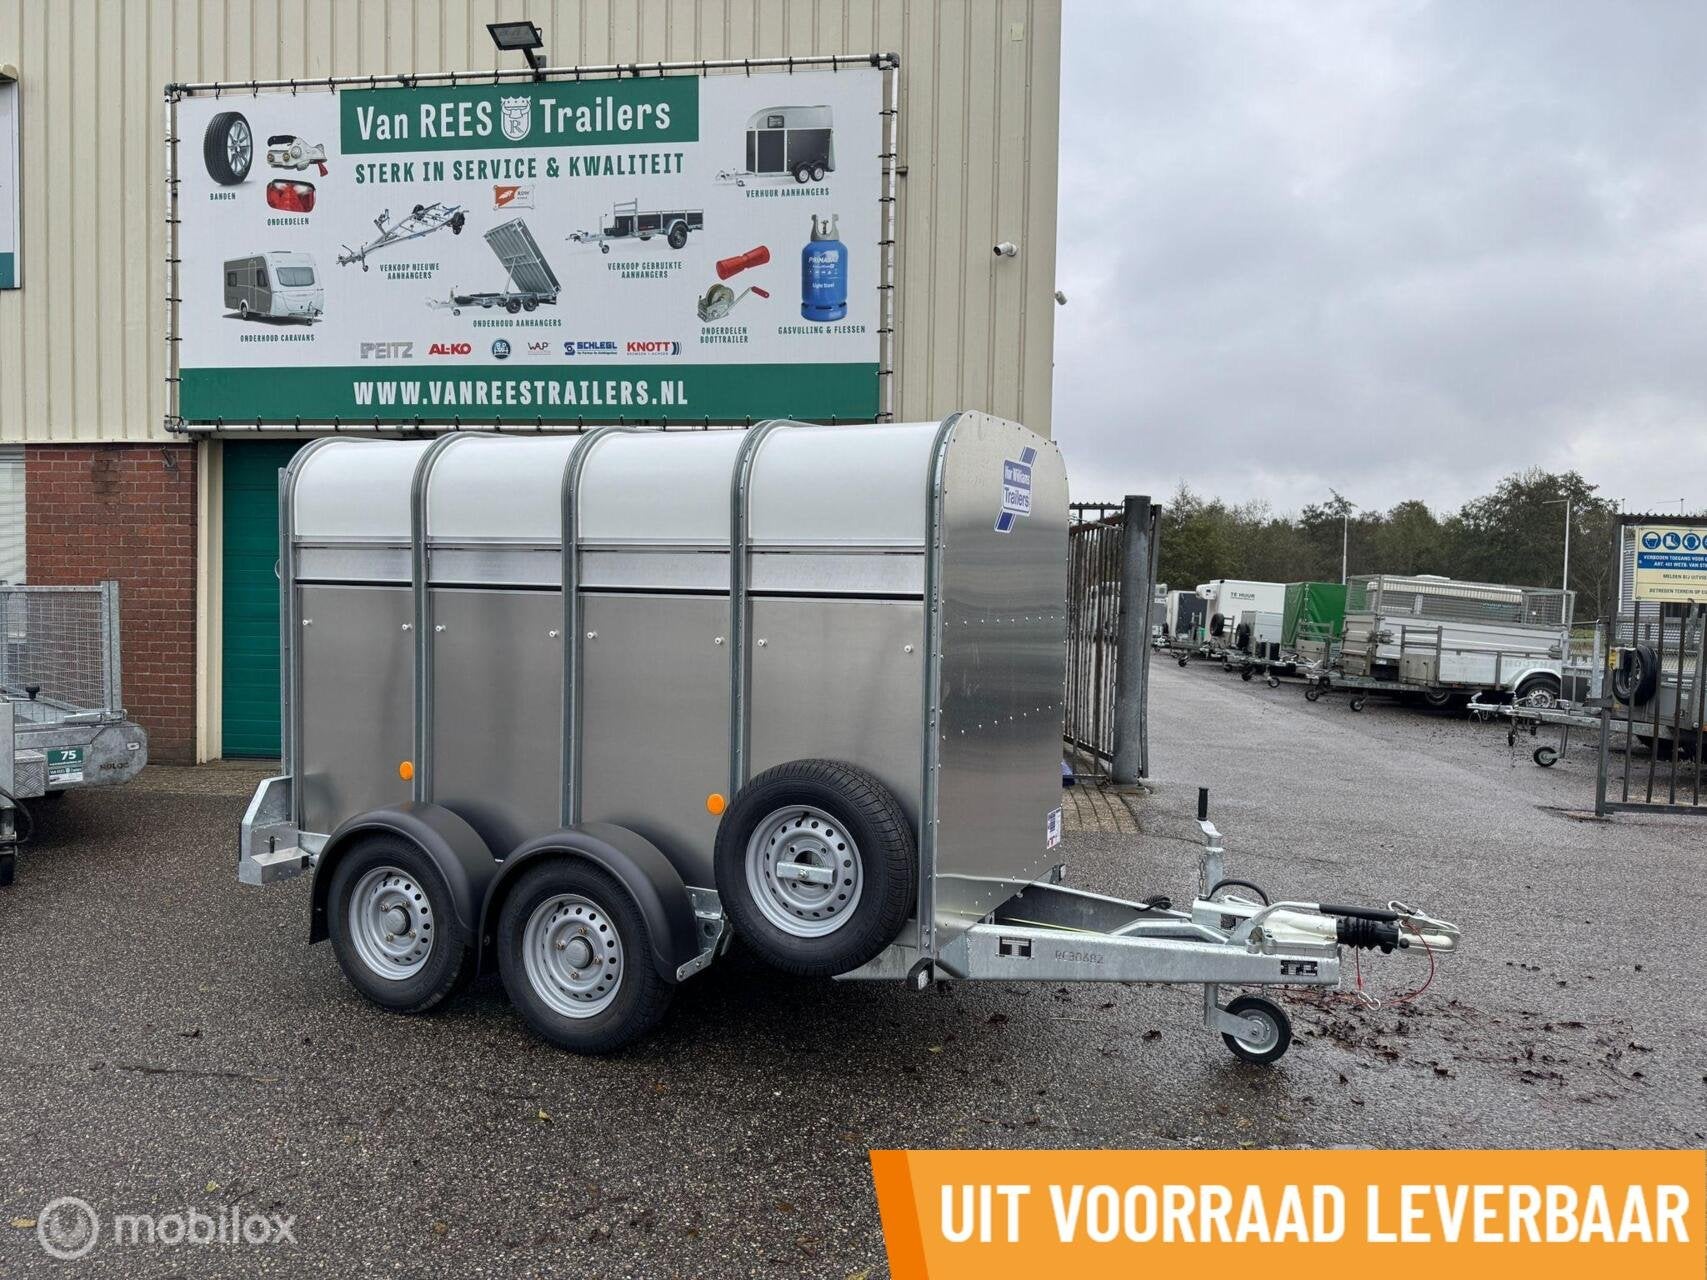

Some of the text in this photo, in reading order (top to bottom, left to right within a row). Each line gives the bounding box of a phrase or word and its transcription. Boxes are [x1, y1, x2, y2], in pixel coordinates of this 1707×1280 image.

[356, 106, 409, 141] Van
[420, 101, 493, 138] REES
[539, 96, 671, 133] Trailers
[355, 153, 684, 184] STERK IN SERVICE & KWALITEIT
[210, 192, 236, 200] BANDEN
[746, 187, 830, 198] VERHUUR AANHANGERS
[267, 217, 310, 226] ONDERDELEN
[380, 262, 440, 272] VERKOOP NIEUWE
[607, 261, 682, 271] VERKOOP GEBRUIKTE
[387, 271, 432, 280] AANHANGERS
[621, 270, 668, 279] AANHANGERS
[472, 319, 562, 328] ONDERHOUD AANHANGERS
[701, 326, 748, 335] ONDERDELEN
[778, 325, 866, 335] GASVULLING & FLESSEN
[240, 334, 315, 342] ONDERHOUD CARAVANS
[700, 335, 749, 344] BOOTTRAILER
[428, 343, 472, 355] AL-KO
[626, 341, 671, 352] KNOTT
[353, 380, 688, 406] WWW.VANREESTRAILERS.NL
[1004, 487, 1030, 508] Trailers
[60, 750, 77, 761] 75
